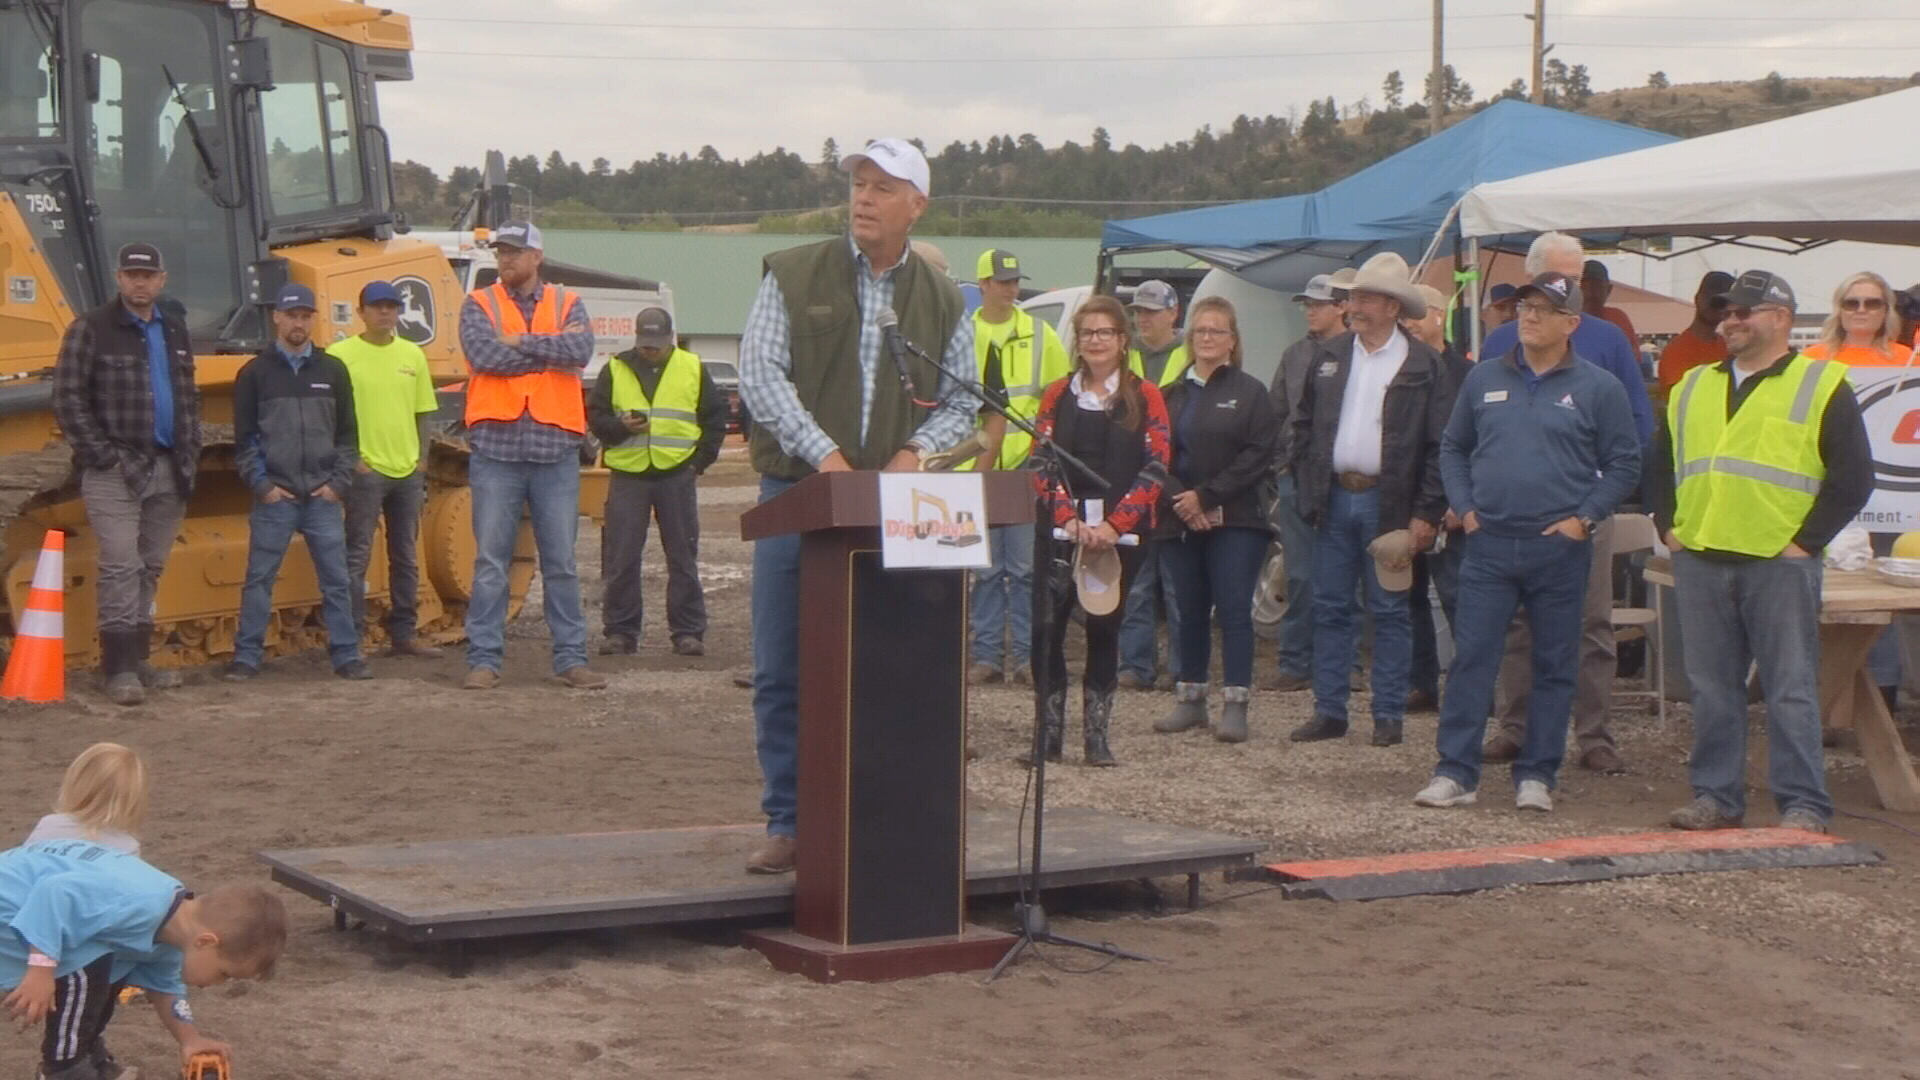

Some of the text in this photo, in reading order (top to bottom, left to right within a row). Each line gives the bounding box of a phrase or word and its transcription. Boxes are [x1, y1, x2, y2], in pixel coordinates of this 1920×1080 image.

[26, 194, 62, 212] 750L
[1857, 511, 1901, 523] tment
[885, 519, 916, 541] Dig
